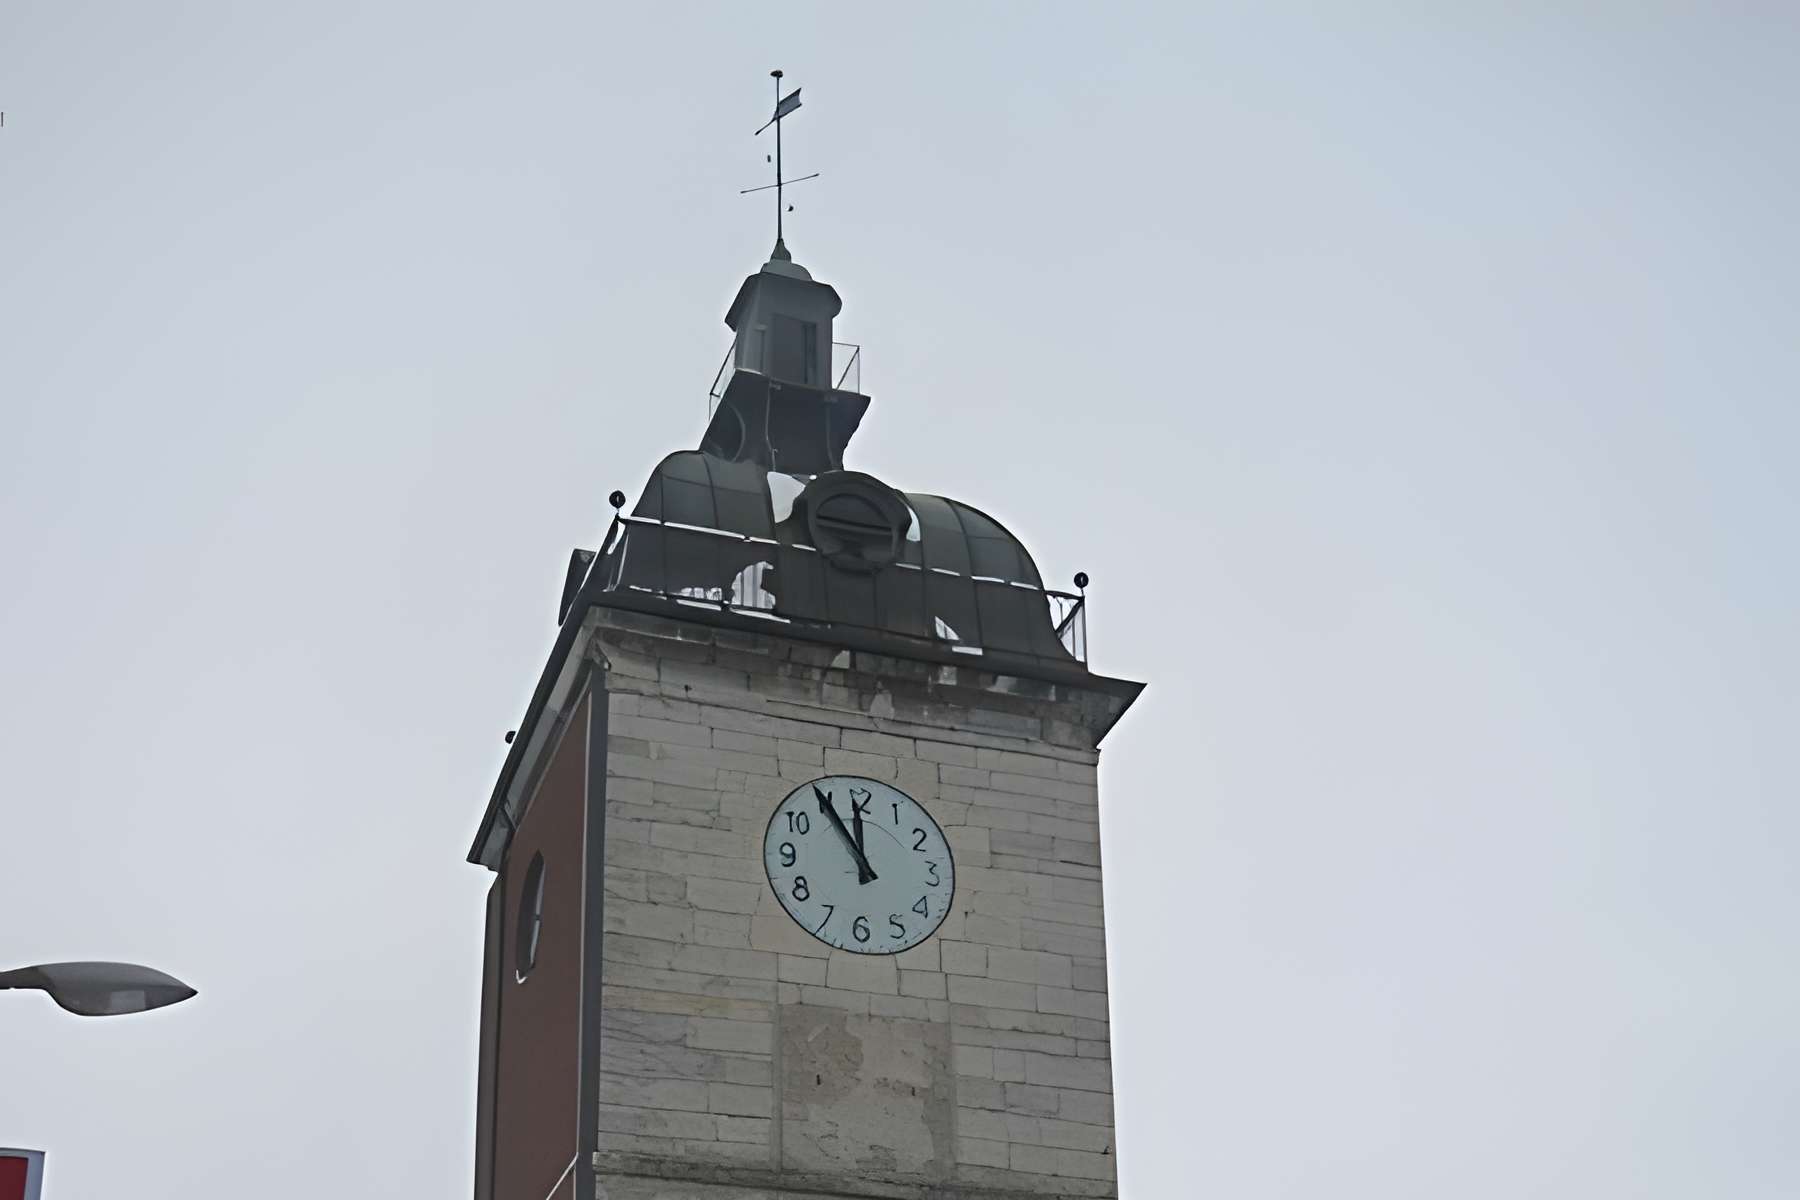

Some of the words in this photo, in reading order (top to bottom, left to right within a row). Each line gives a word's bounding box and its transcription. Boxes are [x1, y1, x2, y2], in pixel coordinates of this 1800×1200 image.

[786, 811, 810, 835] 10
[891, 803, 899, 825] 1
[912, 828, 928, 852] 2
[779, 842, 797, 867] 9
[925, 861, 940, 887] 3
[792, 876, 810, 901] 8
[815, 904, 834, 935] 7
[912, 895, 929, 919] 4
[852, 916, 871, 943] 6
[889, 914, 906, 939] 5
